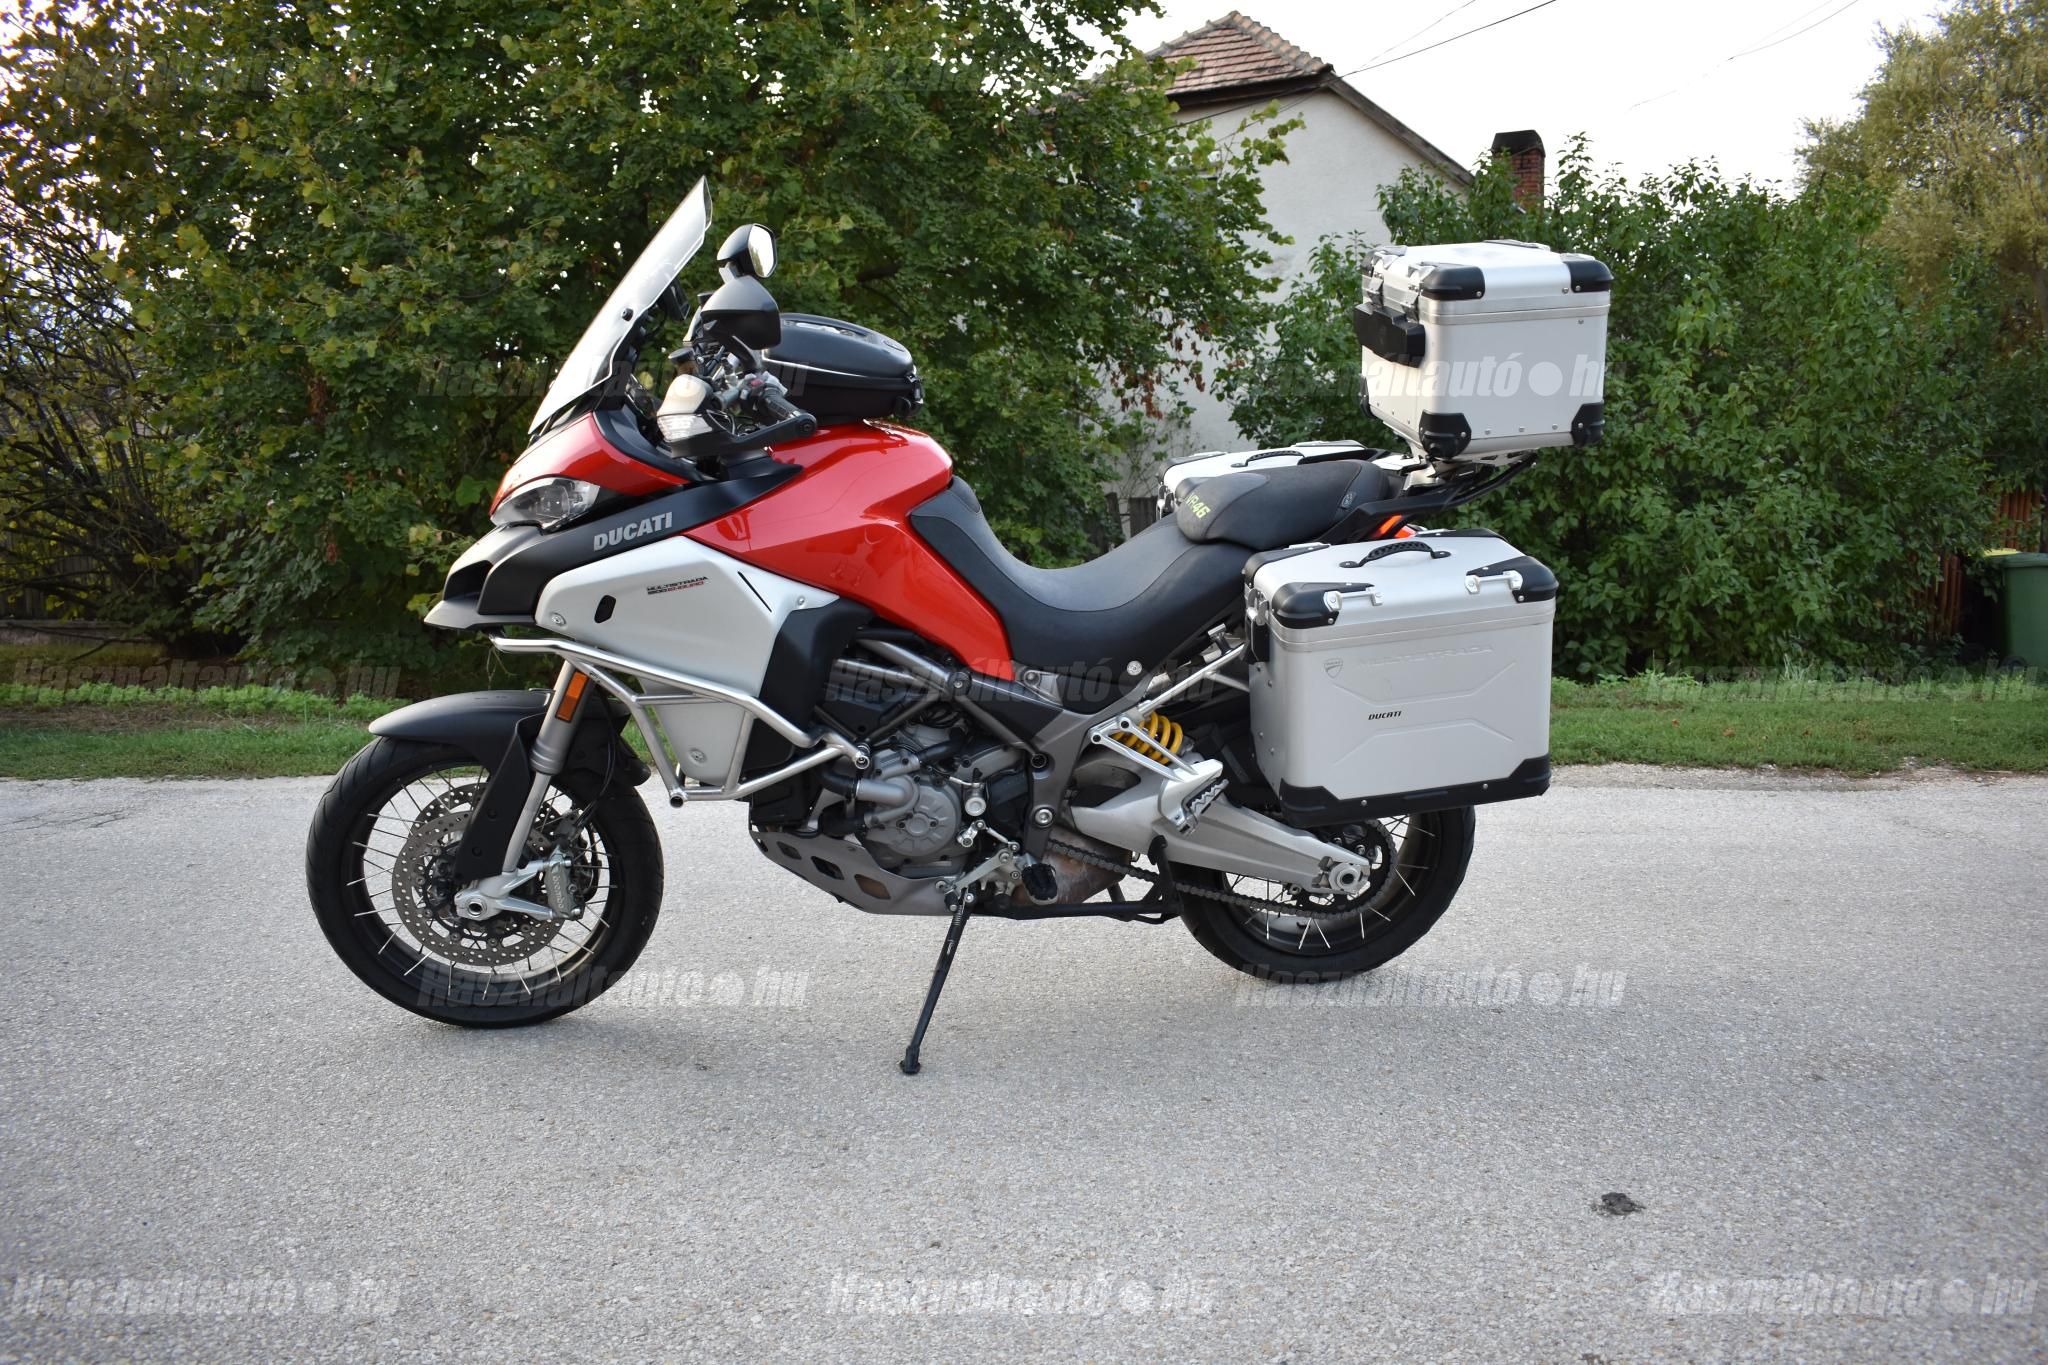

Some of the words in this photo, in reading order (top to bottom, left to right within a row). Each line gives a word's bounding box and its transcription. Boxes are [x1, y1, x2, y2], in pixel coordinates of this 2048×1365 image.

[1184, 492, 1211, 519] VR46
[593, 511, 673, 552] DUCATI
[1367, 710, 1403, 721] DUCATI
